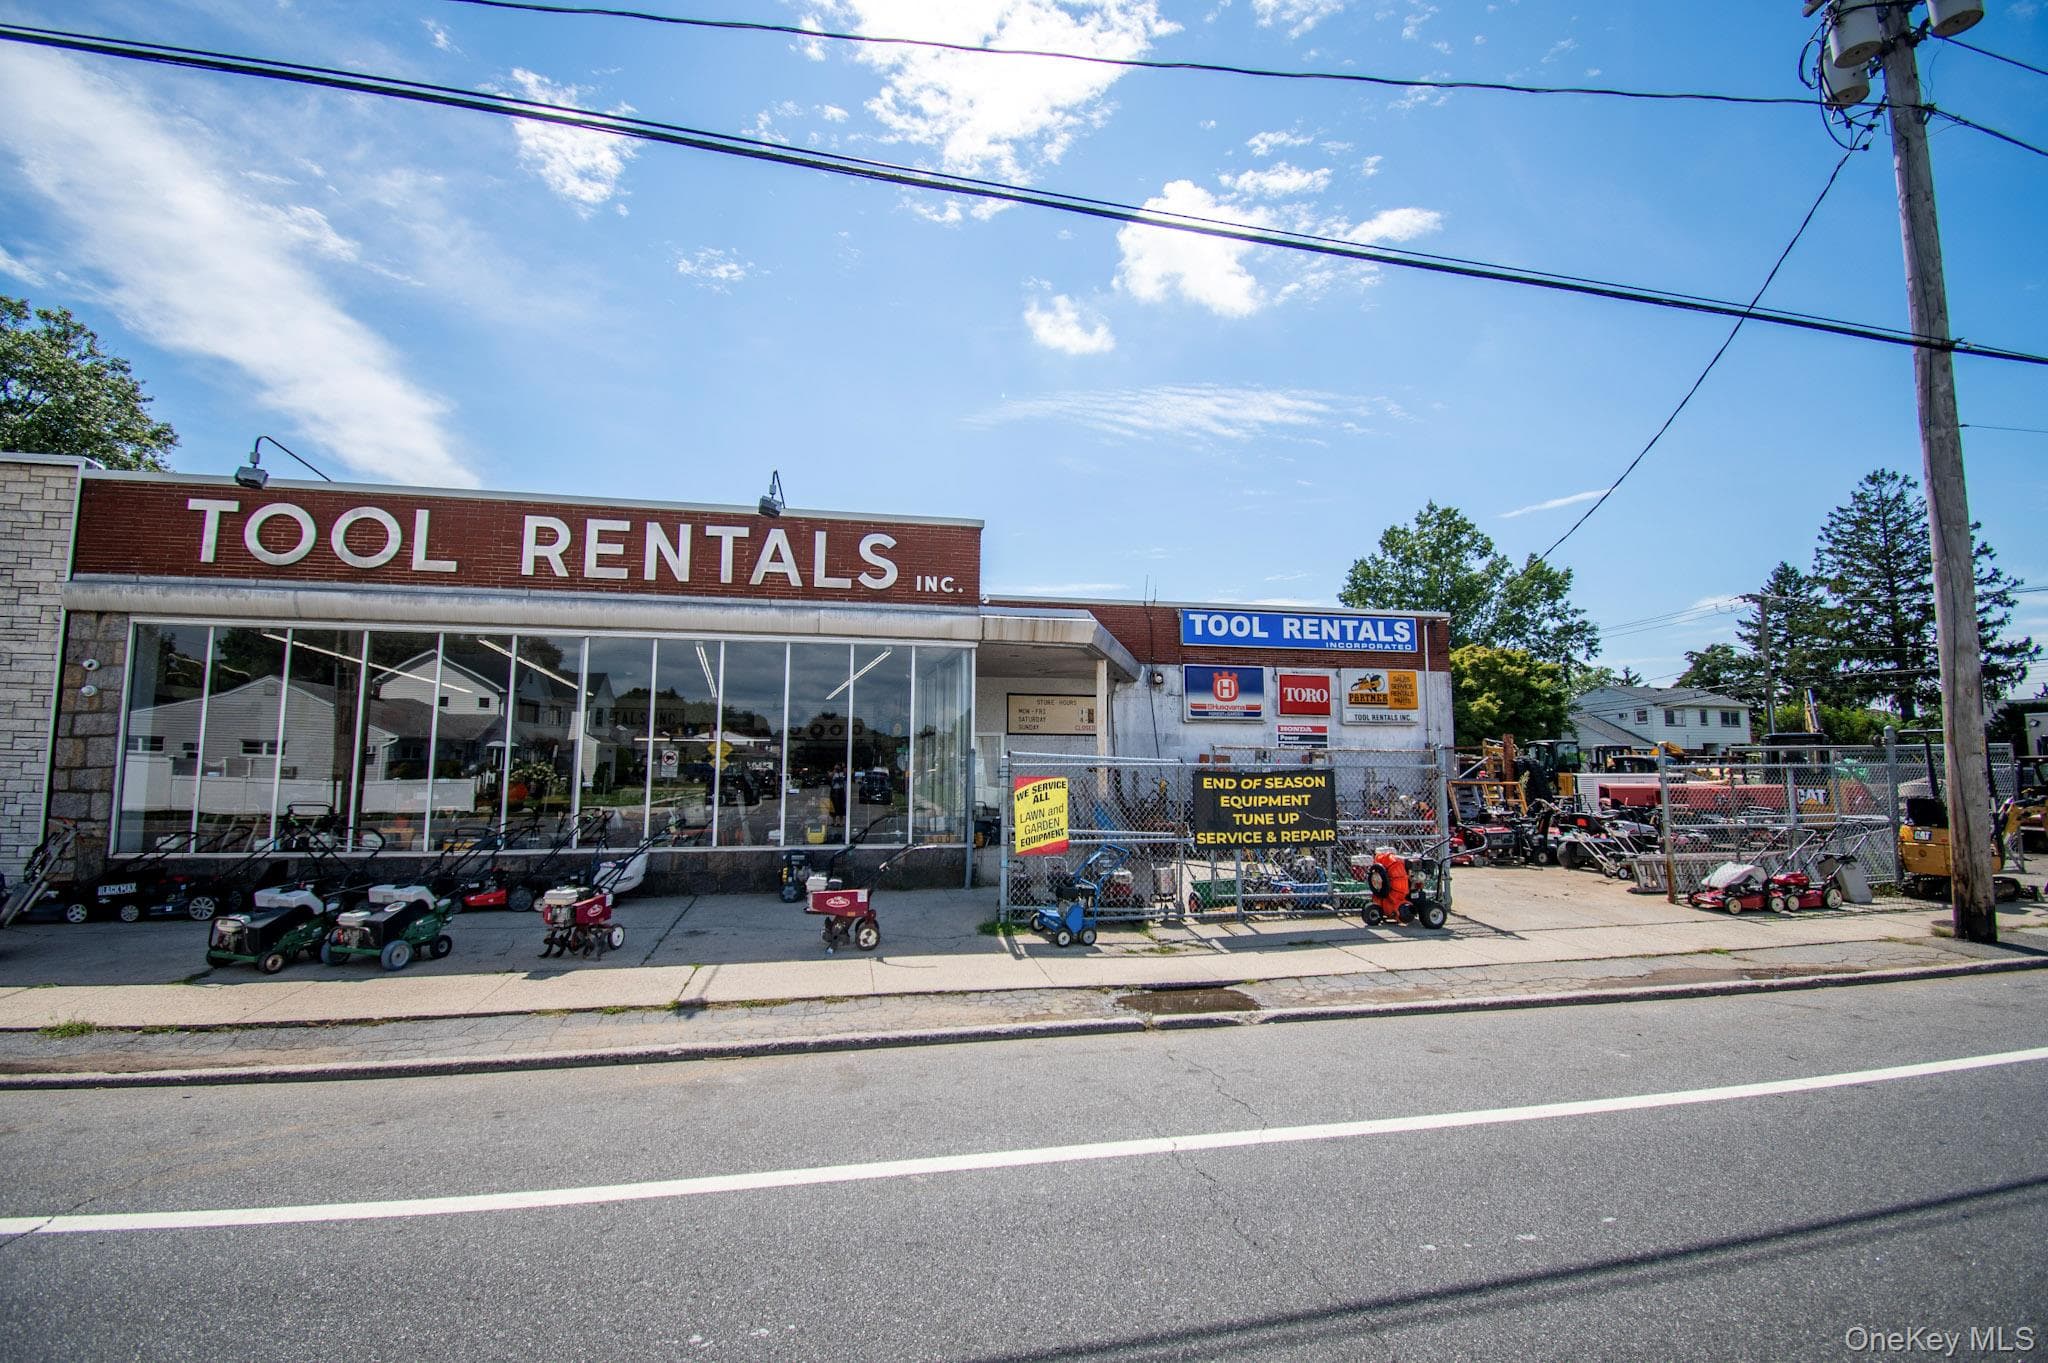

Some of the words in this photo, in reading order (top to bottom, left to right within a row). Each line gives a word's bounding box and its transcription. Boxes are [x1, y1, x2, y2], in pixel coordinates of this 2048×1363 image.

[187, 498, 457, 573] TOOL
[520, 515, 899, 590] RENTALS
[915, 574, 964, 594] INC.
[1188, 613, 1269, 638] TOOL
[1282, 617, 1411, 643] RENTALS
[1325, 641, 1412, 651] INCORPORATED
[1283, 687, 1328, 704] TORO
[1349, 693, 1388, 703] PARTNER
[1202, 777, 1236, 789] END
[1240, 778, 1262, 789] OF
[1264, 776, 1326, 789] SEASON
[1016, 788, 1030, 802] WE
[1031, 780, 1067, 795] SERVICE
[1032, 791, 1050, 805] ALL
[1797, 788, 1827, 805] CAT
[1220, 794, 1312, 809] EQUIPMENT
[1020, 808, 1045, 824] LAWN
[1047, 802, 1064, 816] and
[1233, 812, 1274, 826] TUNE
[1279, 812, 1300, 824] UP
[1024, 816, 1060, 835] GARDEN
[1020, 827, 1065, 848] EQUIPMENT
[1196, 831, 1263, 845] SERVICE
[1266, 830, 1277, 843] &
[1281, 829, 1336, 843] REPAIR
[1915, 831, 1931, 840] CAT
